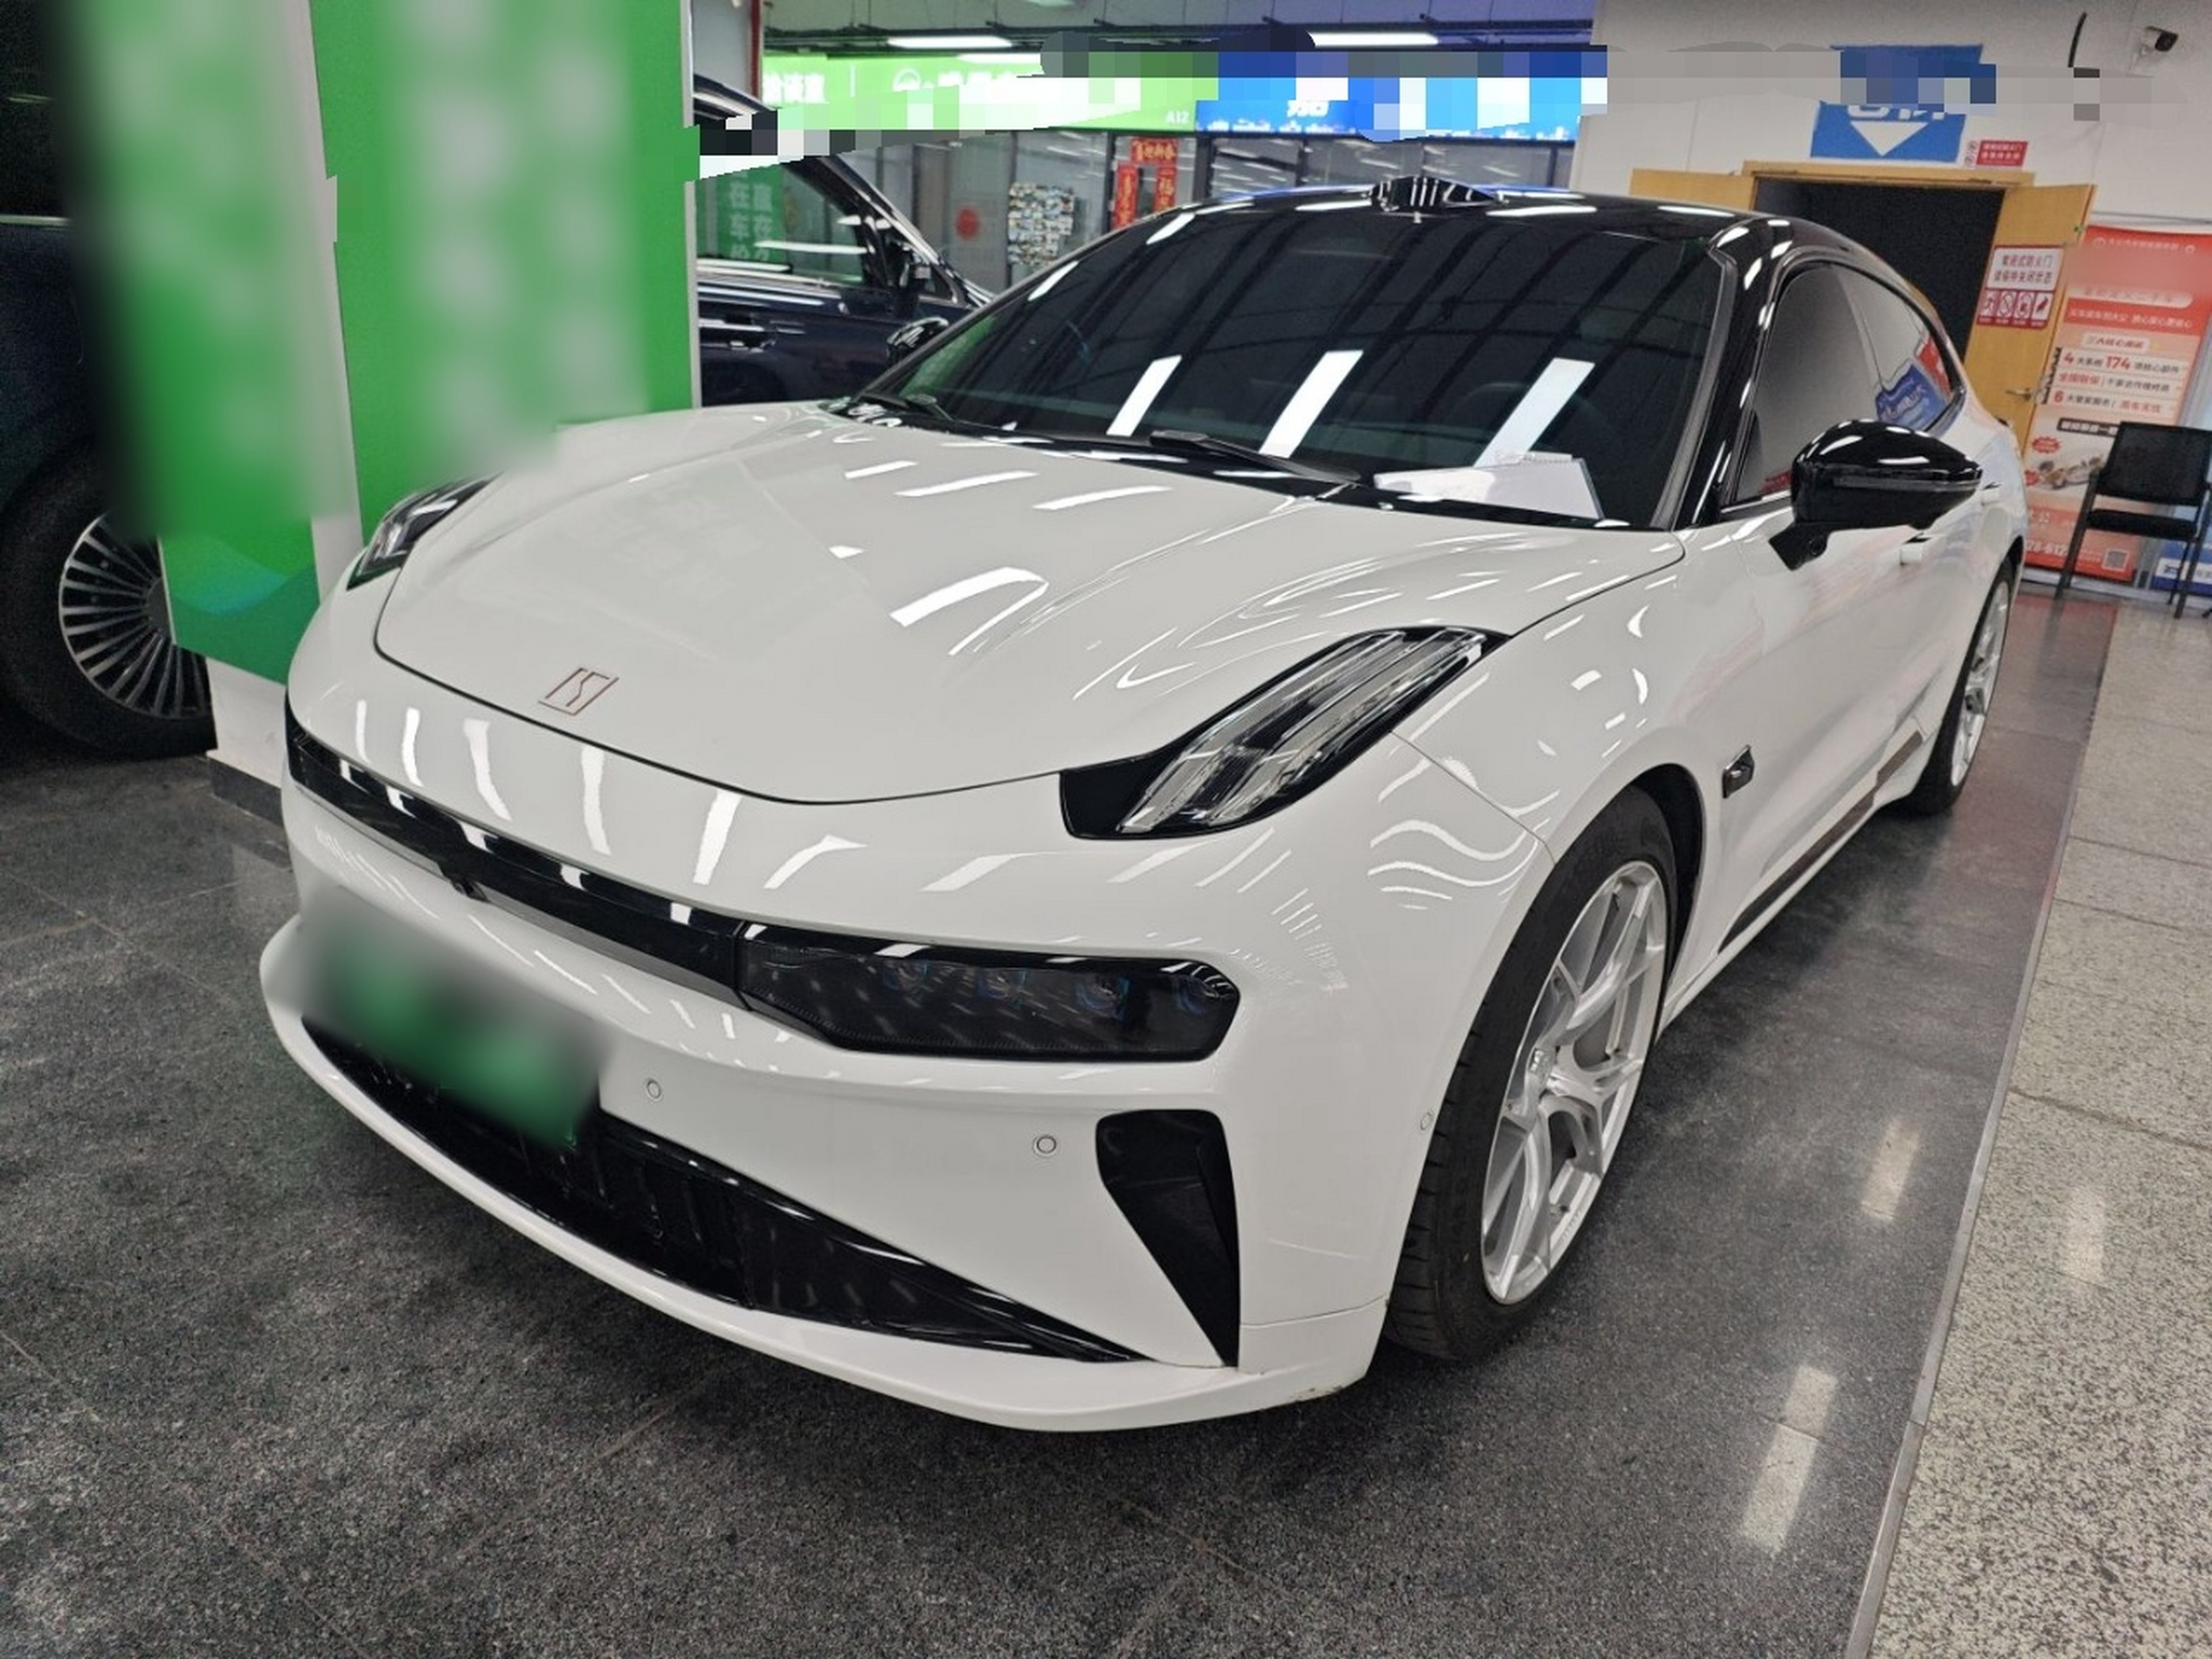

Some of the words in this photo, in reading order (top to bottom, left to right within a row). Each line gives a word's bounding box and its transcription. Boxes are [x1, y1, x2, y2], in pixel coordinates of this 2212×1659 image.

[1165, 110, 1190, 124] A12
[2064, 352, 2074, 365] 4
[2107, 355, 2131, 370] 174
[2054, 390, 2065, 403] 6
